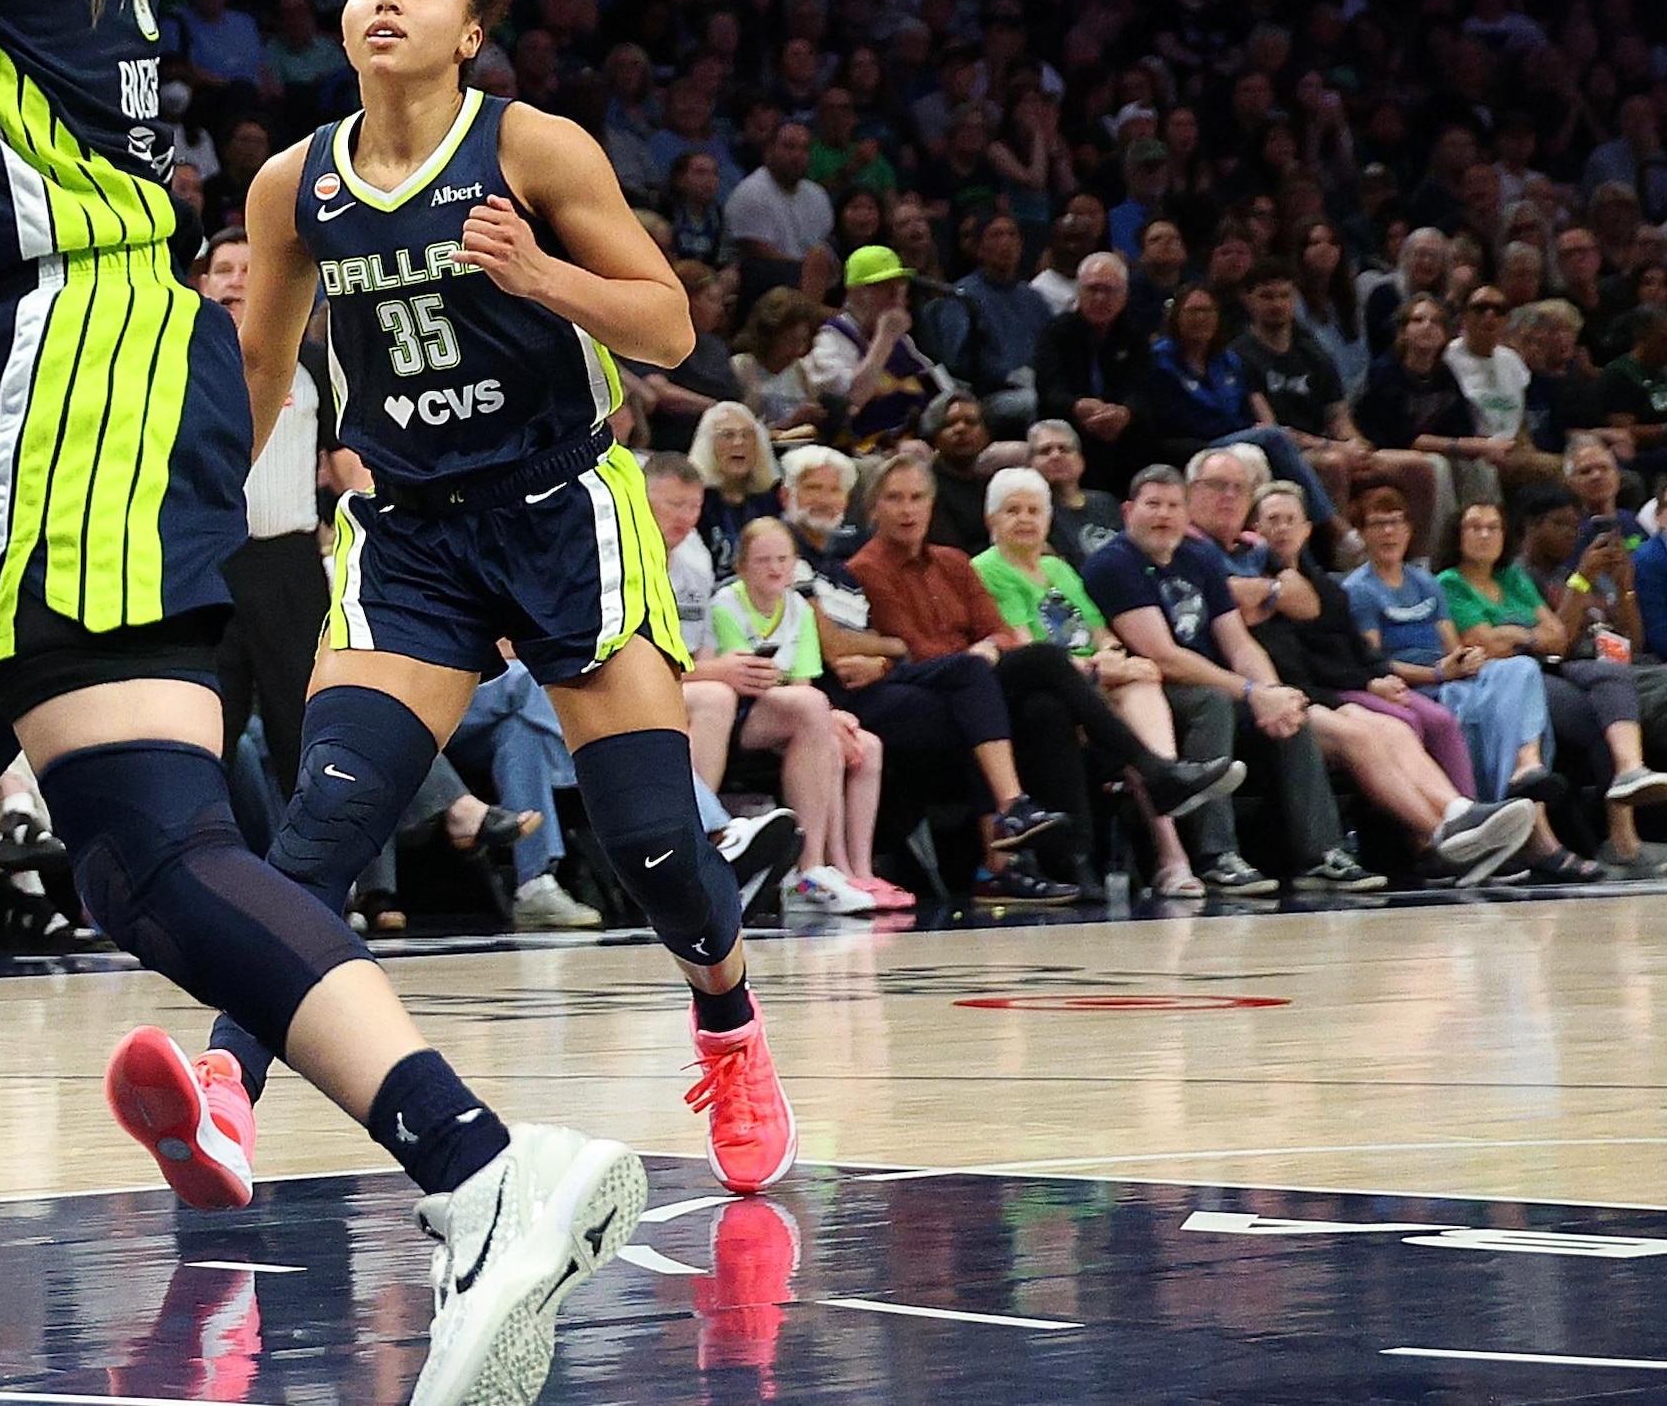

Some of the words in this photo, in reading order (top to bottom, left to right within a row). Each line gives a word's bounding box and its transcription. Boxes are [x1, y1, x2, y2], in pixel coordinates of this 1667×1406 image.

[430, 182, 483, 207] Albert
[320, 240, 487, 296] DALLA
[375, 293, 461, 377] 35
[417, 379, 505, 425] CVS
